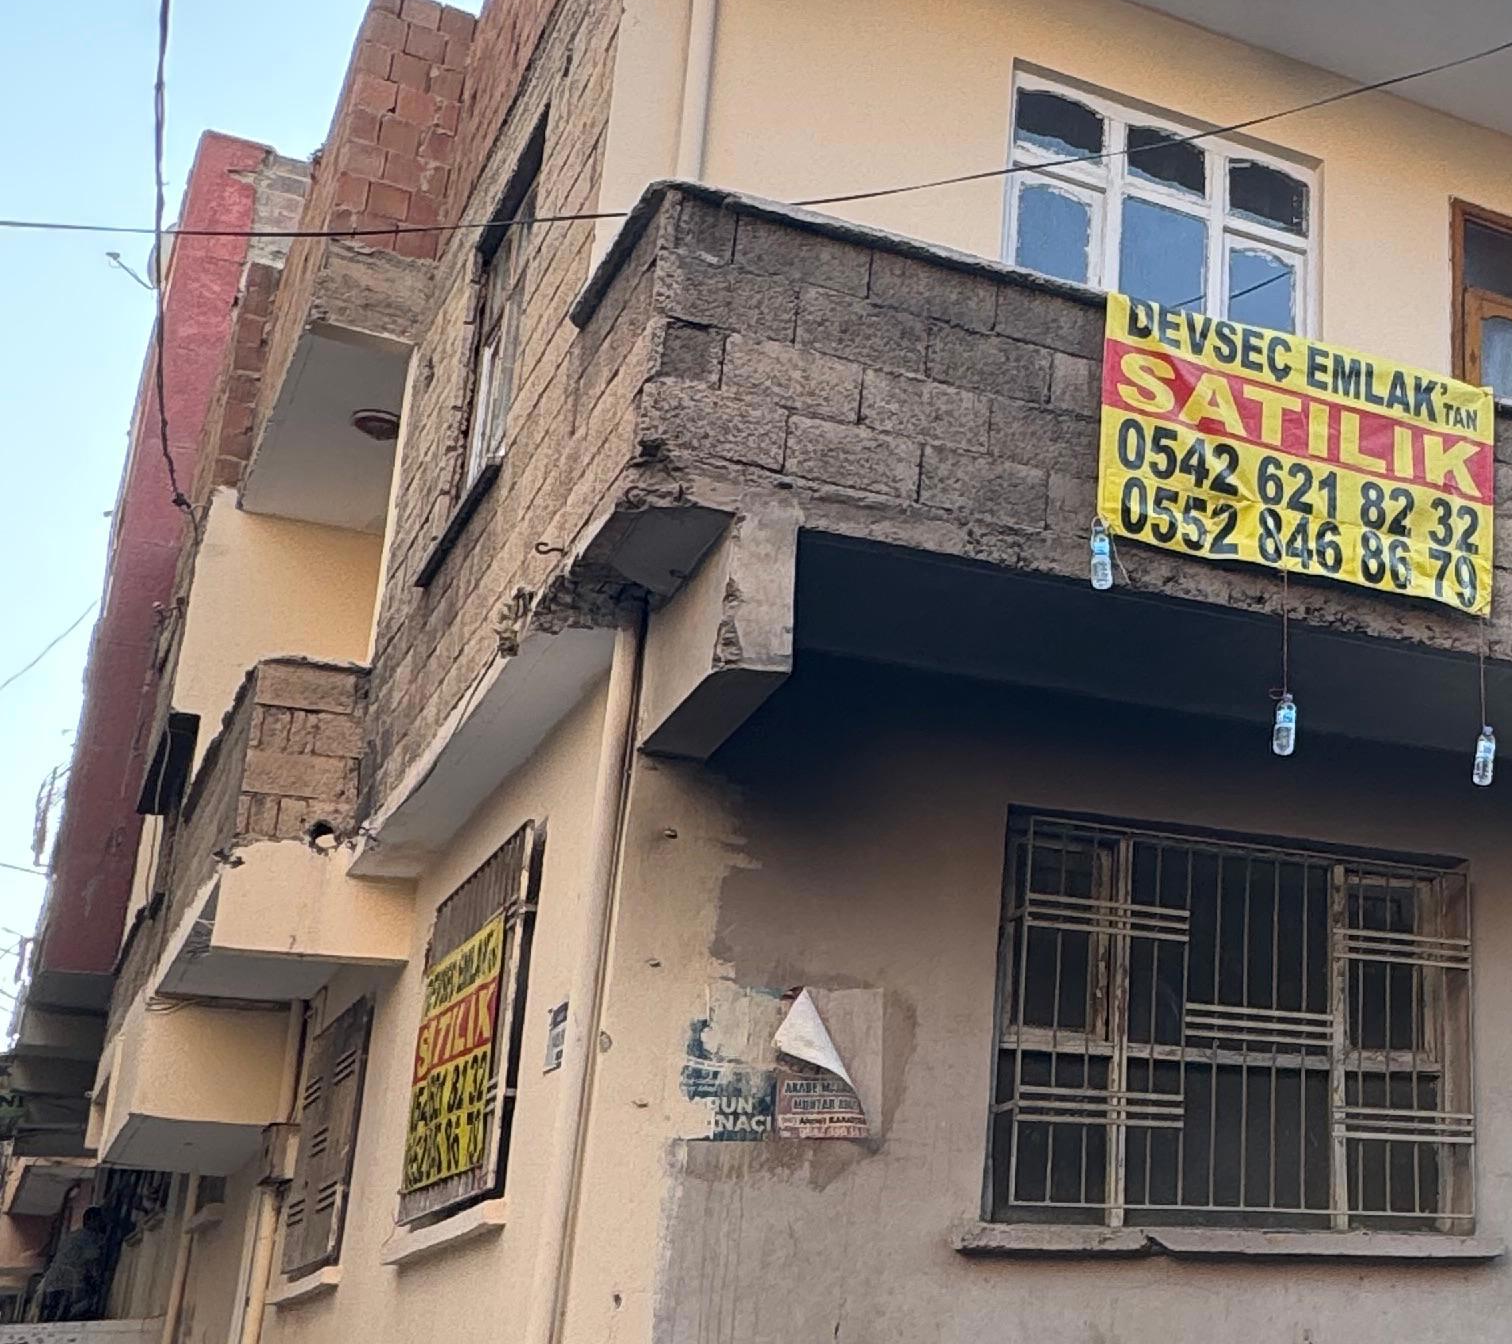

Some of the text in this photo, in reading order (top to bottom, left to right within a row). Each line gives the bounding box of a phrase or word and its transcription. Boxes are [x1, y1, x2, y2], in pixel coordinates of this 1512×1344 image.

[1127, 297, 1291, 382] DEVSEÇ
[1116, 353, 1482, 497] SATILIK
[1118, 418, 1480, 555] 0542 621 82 32
[1121, 476, 1477, 609] 0552 846 86 79
